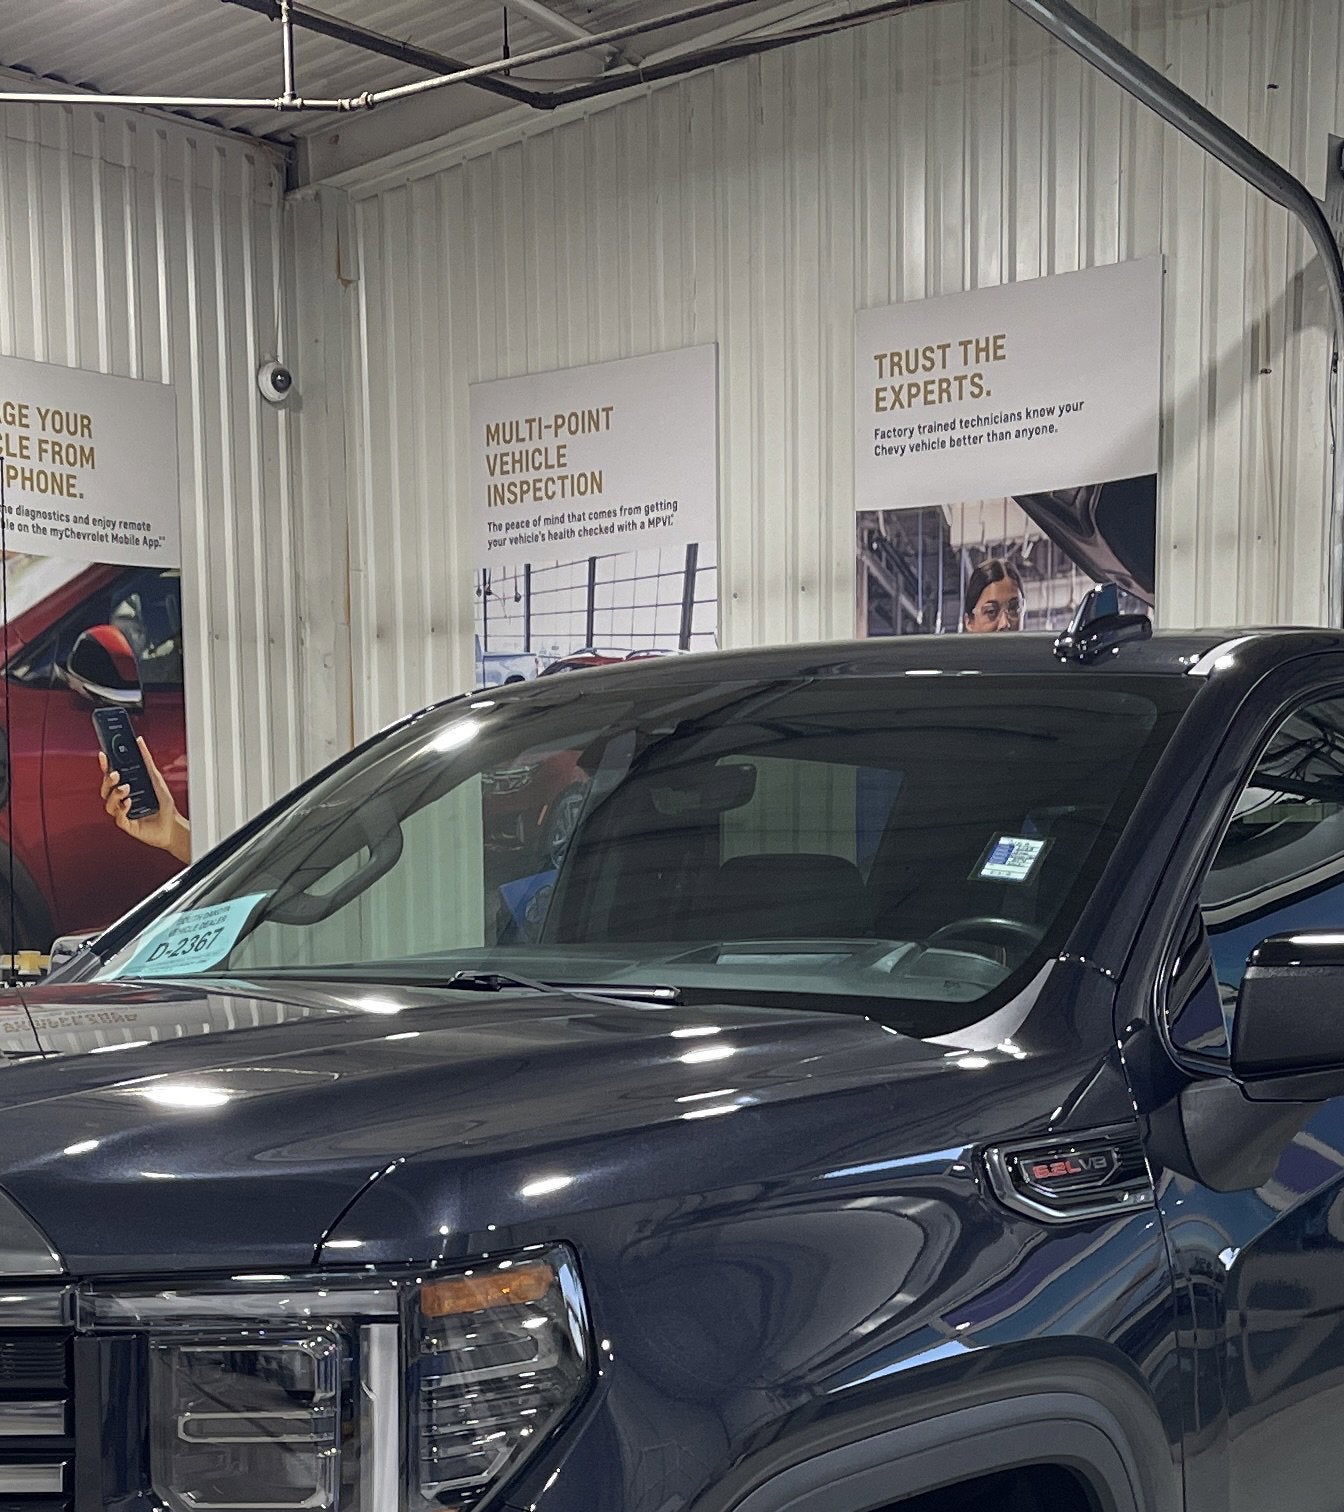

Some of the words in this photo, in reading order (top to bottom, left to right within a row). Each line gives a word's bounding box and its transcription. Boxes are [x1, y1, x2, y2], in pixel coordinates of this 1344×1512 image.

[874, 343, 951, 380] TRUST
[958, 334, 1006, 367] THE
[875, 372, 992, 413] EXPERTS.
[36, 406, 93, 439] YOUR
[485, 406, 614, 448] MULTI-POINT
[874, 425, 914, 441] Factory
[918, 418, 956, 435] trained
[959, 411, 1023, 430] technicians
[1025, 406, 1055, 420] know
[1058, 400, 1085, 417] your
[38, 438, 96, 470] FROM
[874, 440, 906, 457] Chevy
[909, 437, 946, 453] vehicle
[949, 432, 983, 448] better
[986, 429, 1012, 443] than
[1014, 423, 1058, 440] anyone.
[486, 444, 567, 477] VEHICLE
[6, 464, 84, 499] PHONE.
[487, 470, 603, 508] INSPECTION
[15, 504, 70, 524] diagnostics
[73, 512, 90, 526] and
[92, 515, 116, 531] enjoy
[118, 519, 151, 533] remote
[17, 521, 29, 533] on
[32, 521, 47, 536] the
[49, 525, 109, 544] myChevrolet
[111, 532, 140, 547] Mobile
[487, 521, 502, 533] The
[505, 517, 530, 534] peace
[532, 515, 541, 527] of
[543, 512, 565, 526] mind
[567, 510, 586, 524] that
[588, 508, 617, 521] comes
[619, 503, 642, 517] from
[644, 499, 678, 517] getting
[487, 536, 507, 550] your
[547, 525, 575, 541] health
[578, 521, 614, 539] checked
[617, 519, 637, 533] with
[639, 521, 645, 530] a
[145, 926, 225, 963] D-2367
